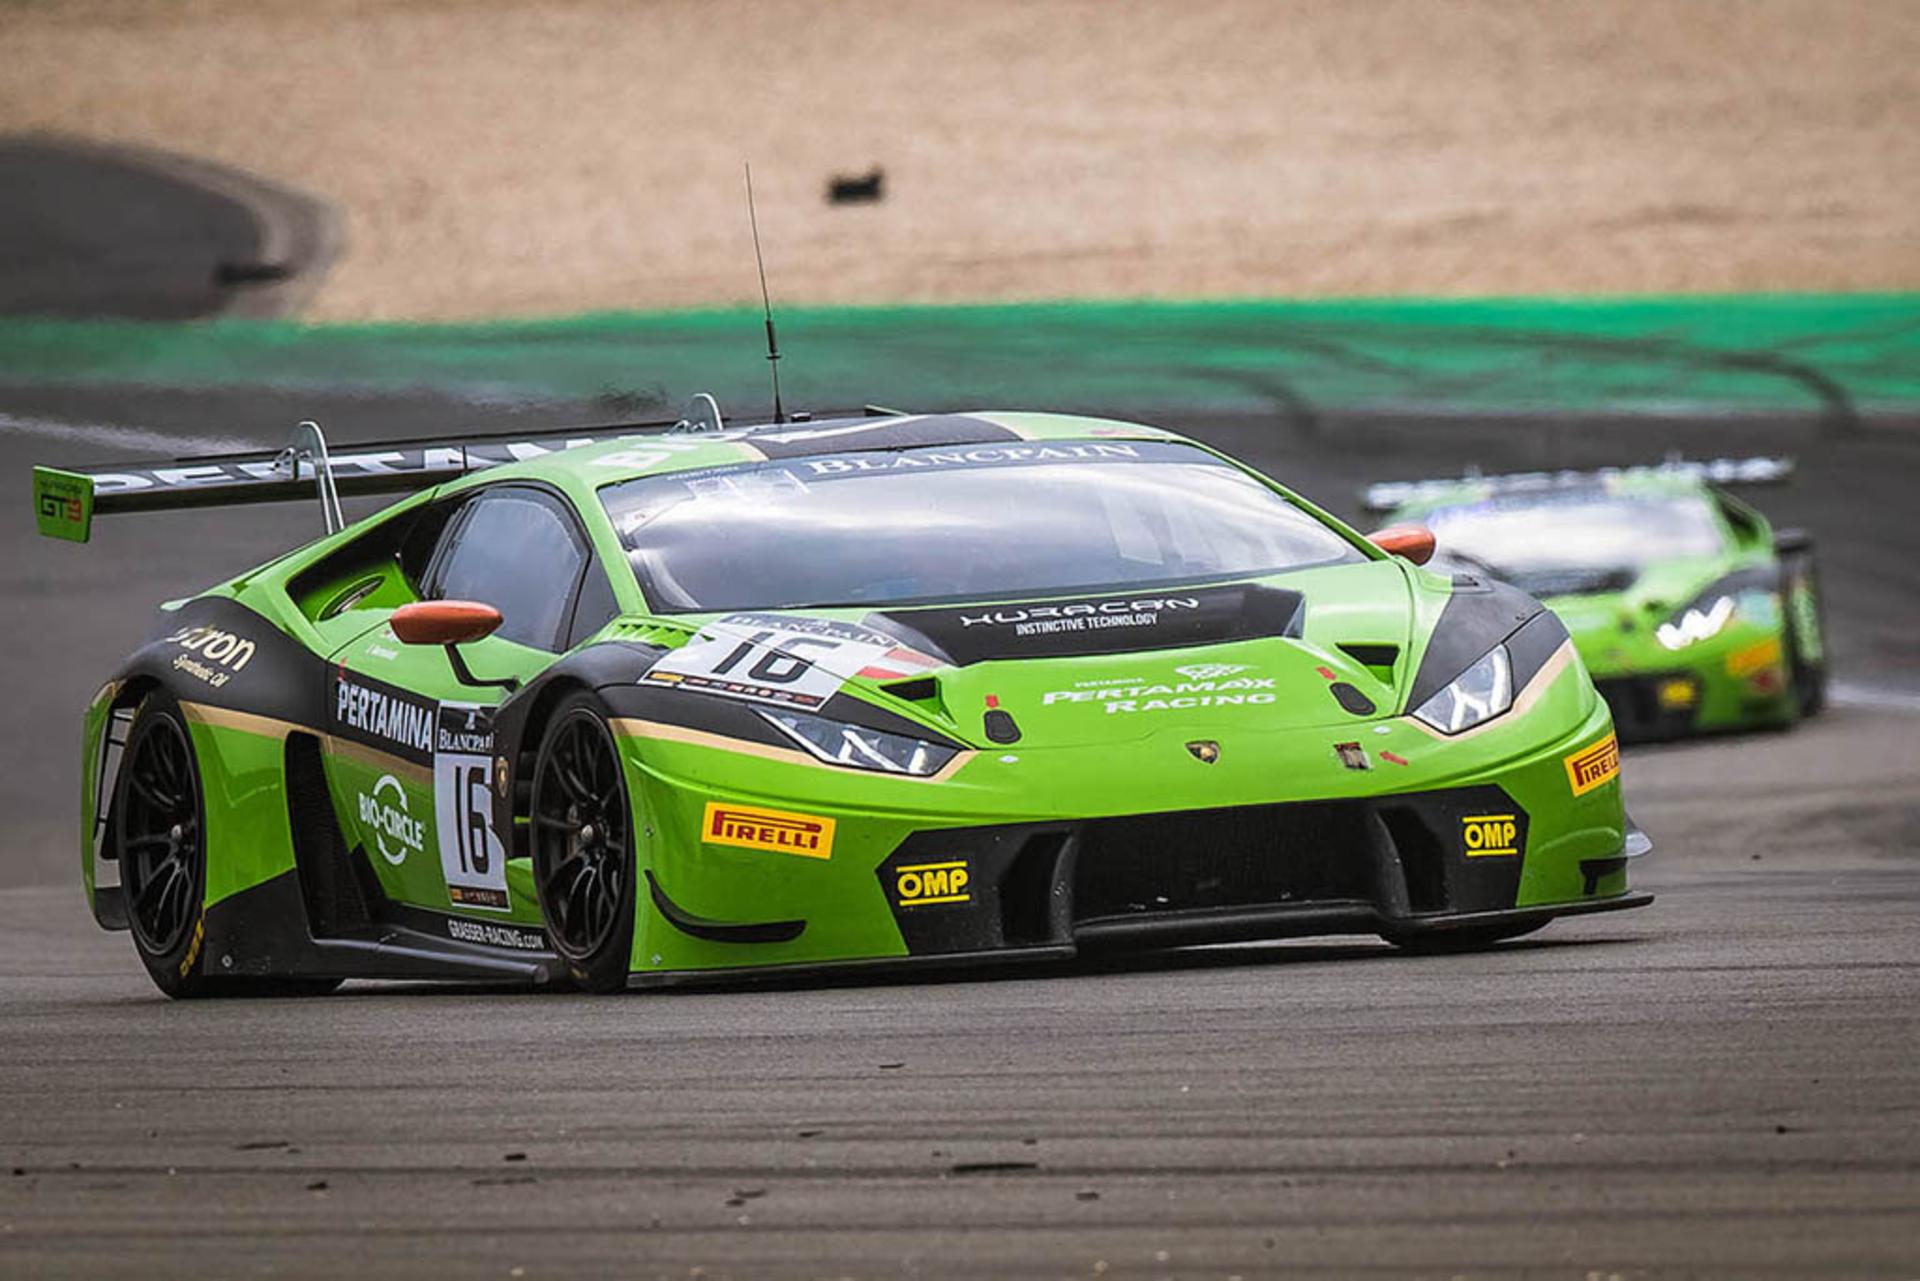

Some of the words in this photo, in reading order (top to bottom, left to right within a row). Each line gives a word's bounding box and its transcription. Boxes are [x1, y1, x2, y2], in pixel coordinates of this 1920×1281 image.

[808, 444, 1140, 474] BLANCPAIN
[1015, 616, 1086, 636] INSTINCTIVE
[1088, 612, 1158, 629] TECHNOLOGY
[711, 631, 842, 684] 16
[1042, 677, 1276, 705] PERTAMAX
[1103, 693, 1276, 714] RACING
[337, 681, 434, 754] PERTAMINA
[358, 792, 424, 852] BIO-CIRCLE
[454, 766, 490, 875] 16
[712, 810, 822, 850] PIRELLI
[1464, 823, 1516, 848] OMP
[897, 869, 969, 898] OMP
[448, 919, 545, 949] GRASSER-RACING.COM
